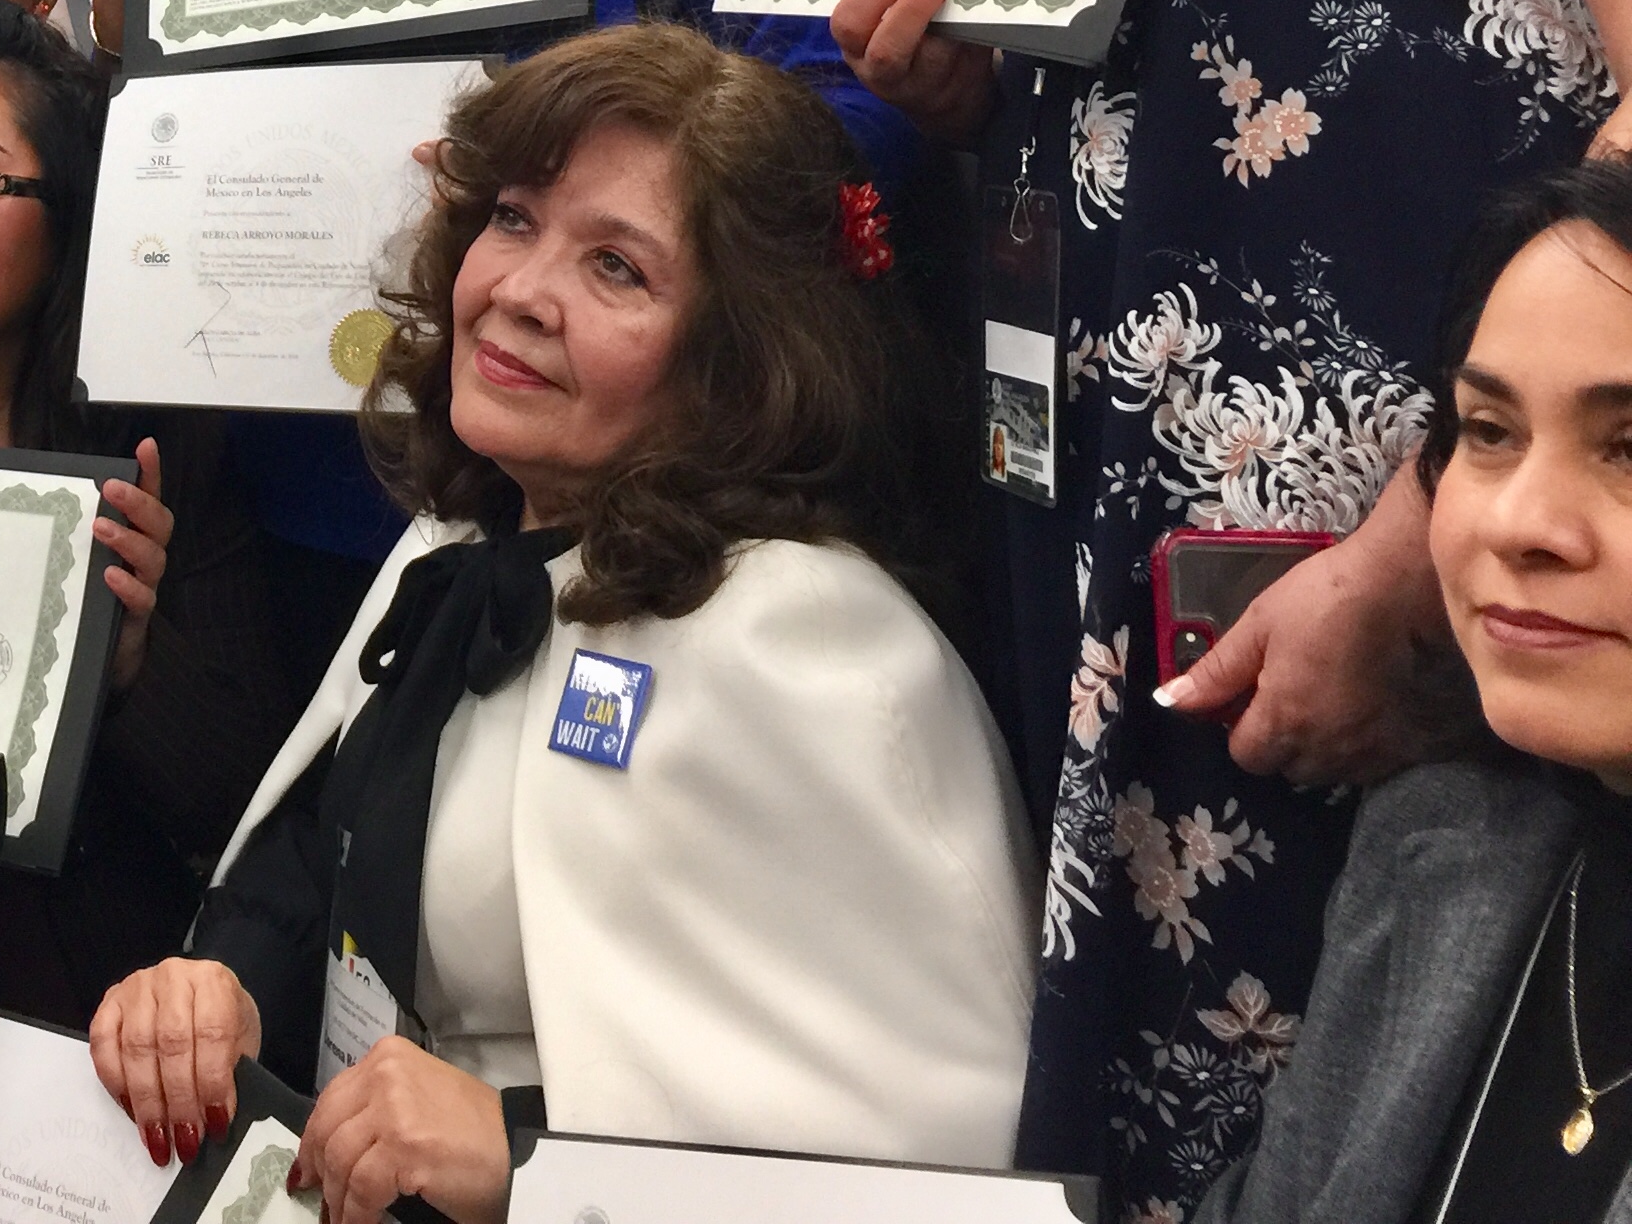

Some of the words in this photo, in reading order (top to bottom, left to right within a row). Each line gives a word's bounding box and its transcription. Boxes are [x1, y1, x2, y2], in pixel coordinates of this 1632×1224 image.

[150, 155, 172, 167] SRE
[143, 251, 170, 263] elac
[556, 719, 601, 752] WAIT
